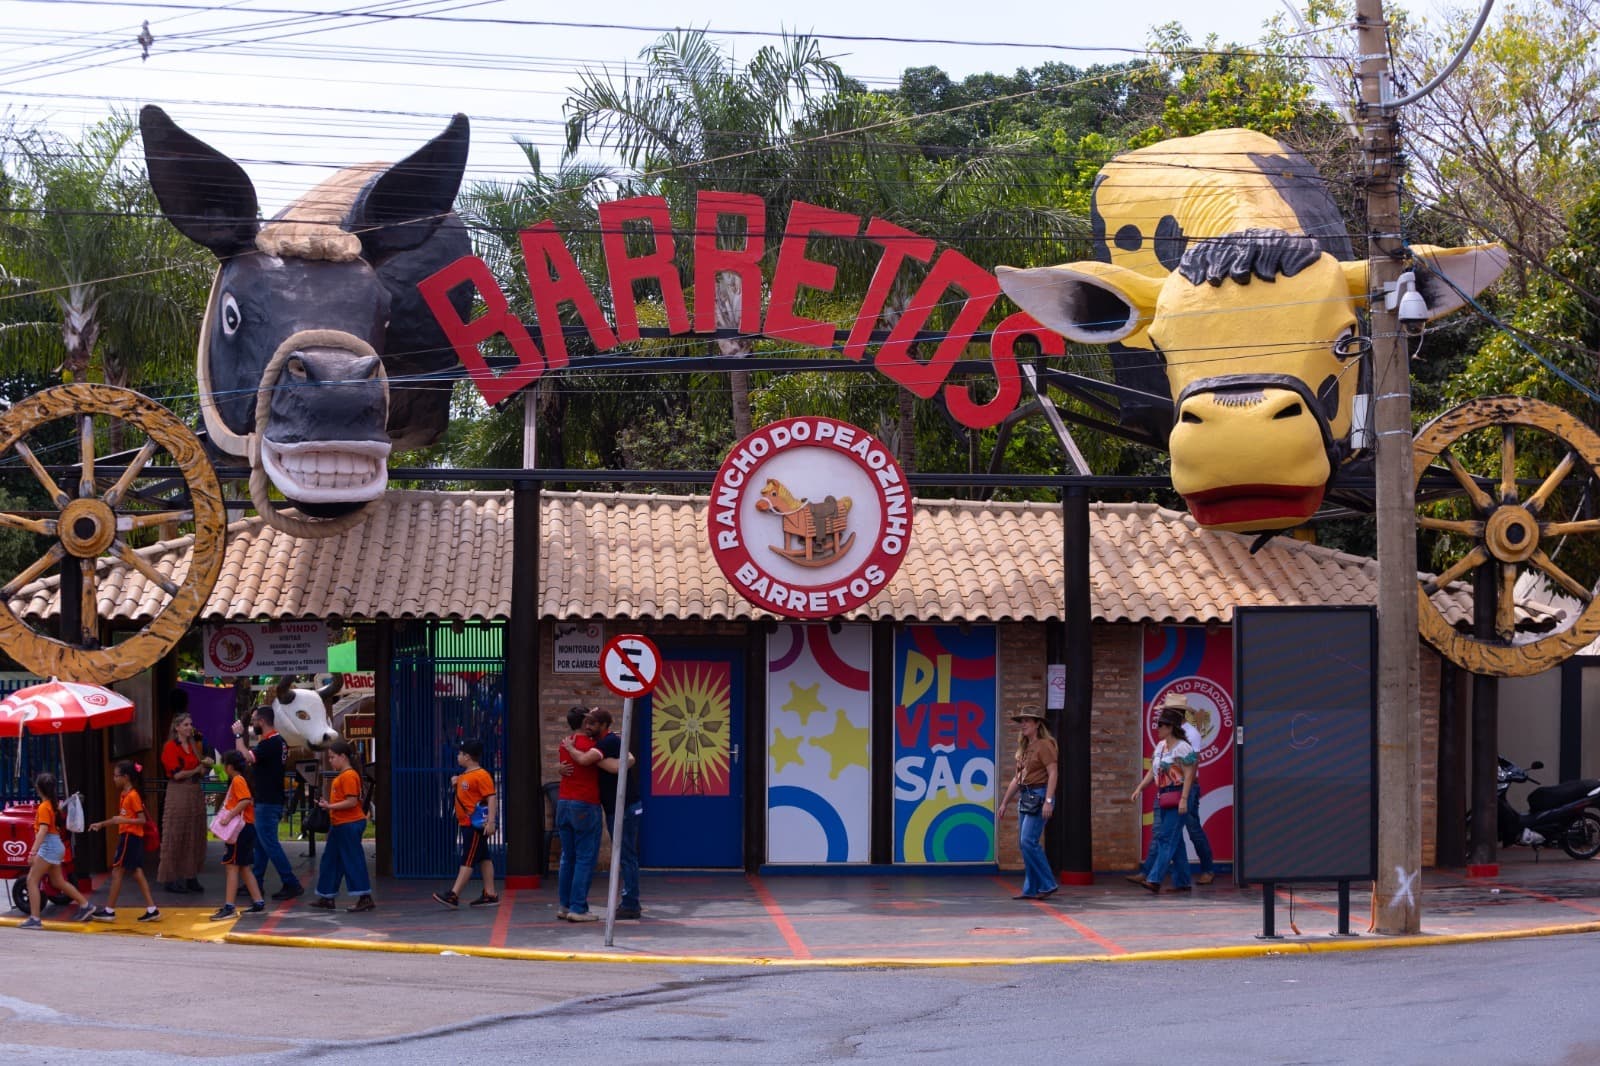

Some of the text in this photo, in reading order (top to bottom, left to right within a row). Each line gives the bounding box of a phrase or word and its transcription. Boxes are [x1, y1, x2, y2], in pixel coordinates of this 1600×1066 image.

[416, 190, 1066, 430] BARRETOS
[716, 421, 908, 555] RANCHO DO PEÃOZINHO
[735, 562, 886, 612] BARRETOS
[557, 660, 571, 669] POR
[558, 645, 600, 655] MONITORADO
[901, 649, 952, 708] DI
[895, 700, 991, 748] VER
[1176, 682, 1192, 693] DO
[1194, 681, 1233, 728] PEÃOZINHO
[895, 743, 995, 802] SÃO
